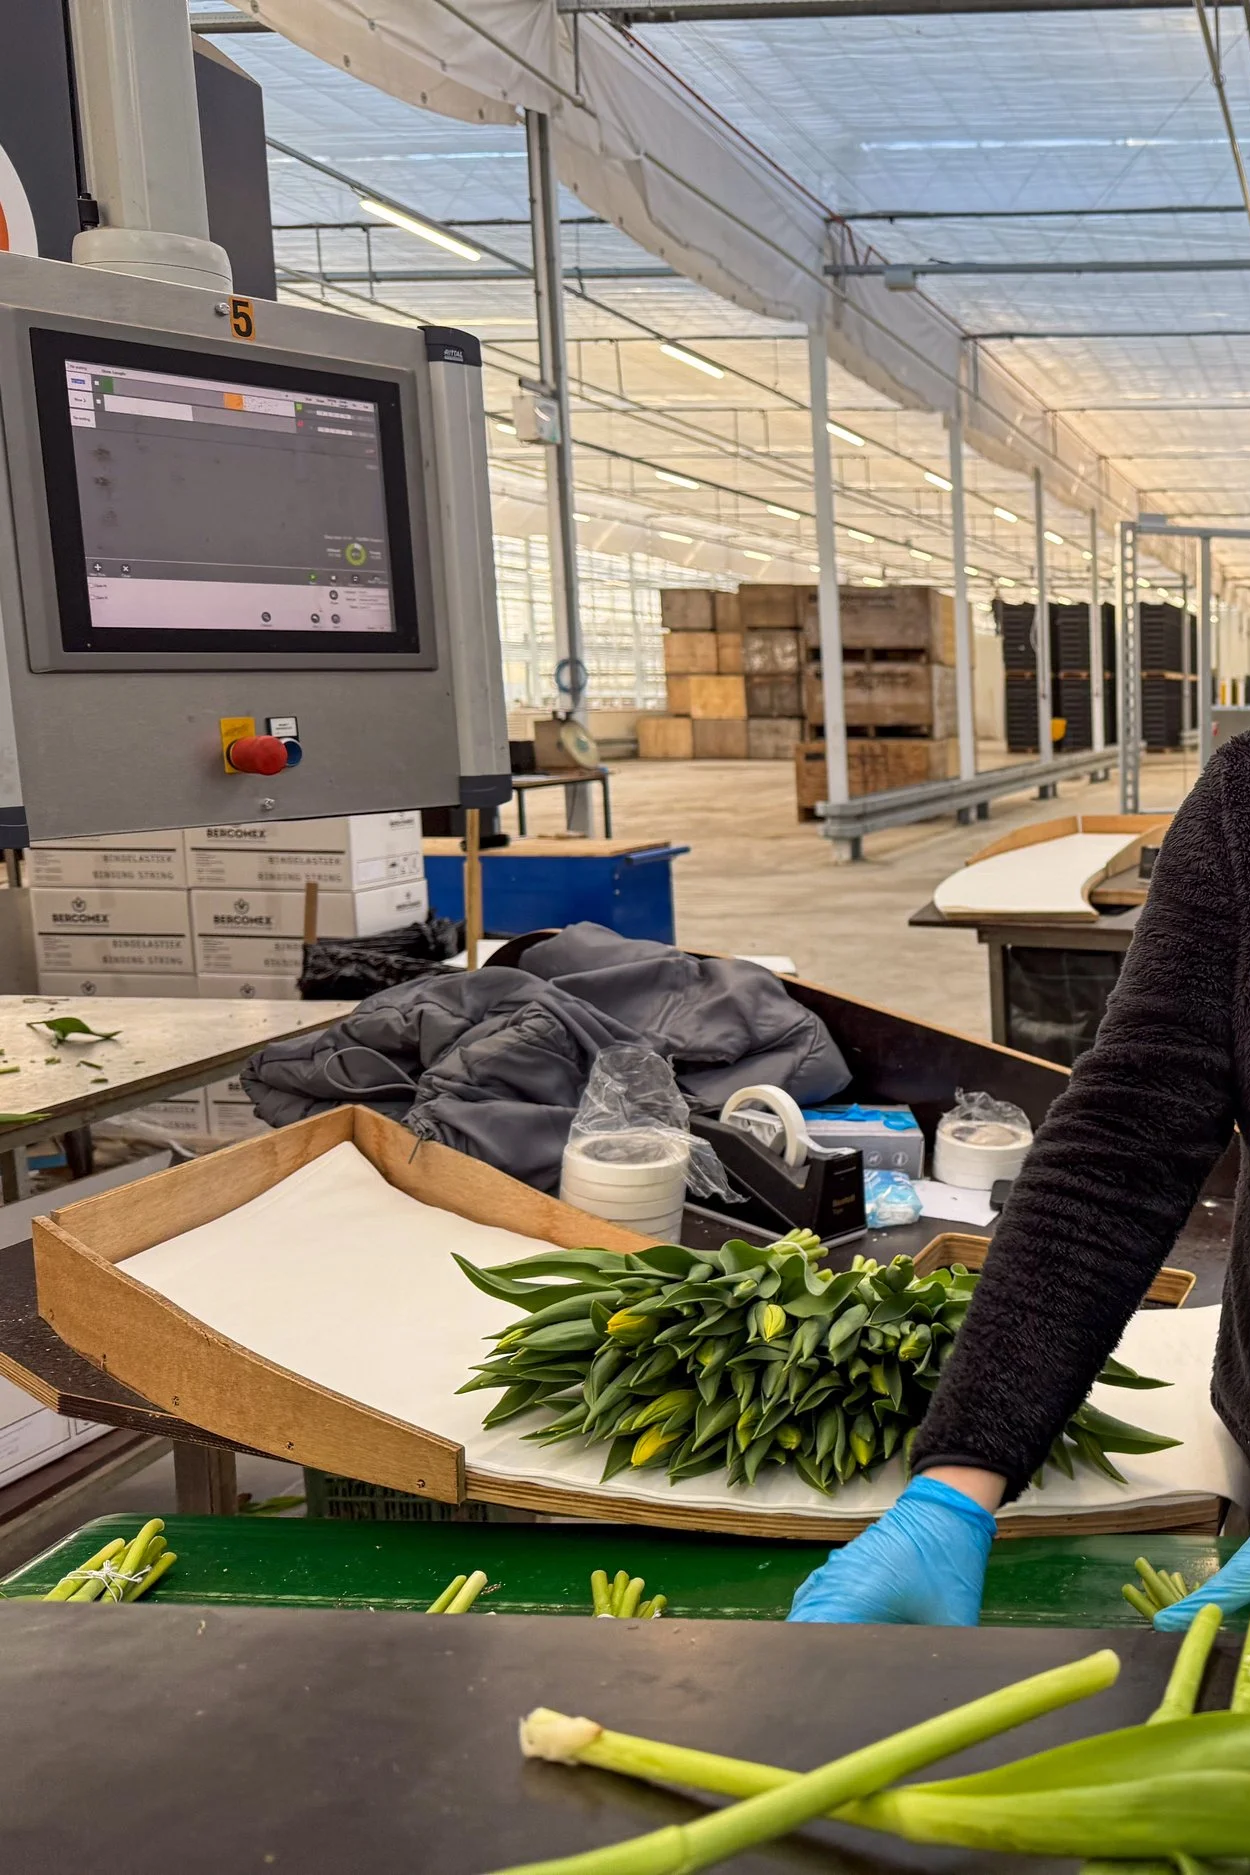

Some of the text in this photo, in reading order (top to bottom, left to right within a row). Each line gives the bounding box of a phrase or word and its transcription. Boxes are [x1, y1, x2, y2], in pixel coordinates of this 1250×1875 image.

[232, 299, 253, 338] 5
[207, 828, 266, 839] BERCOMEX
[52, 913, 109, 923] BERCOMEX
[213, 914, 272, 925] BERCOMEX
